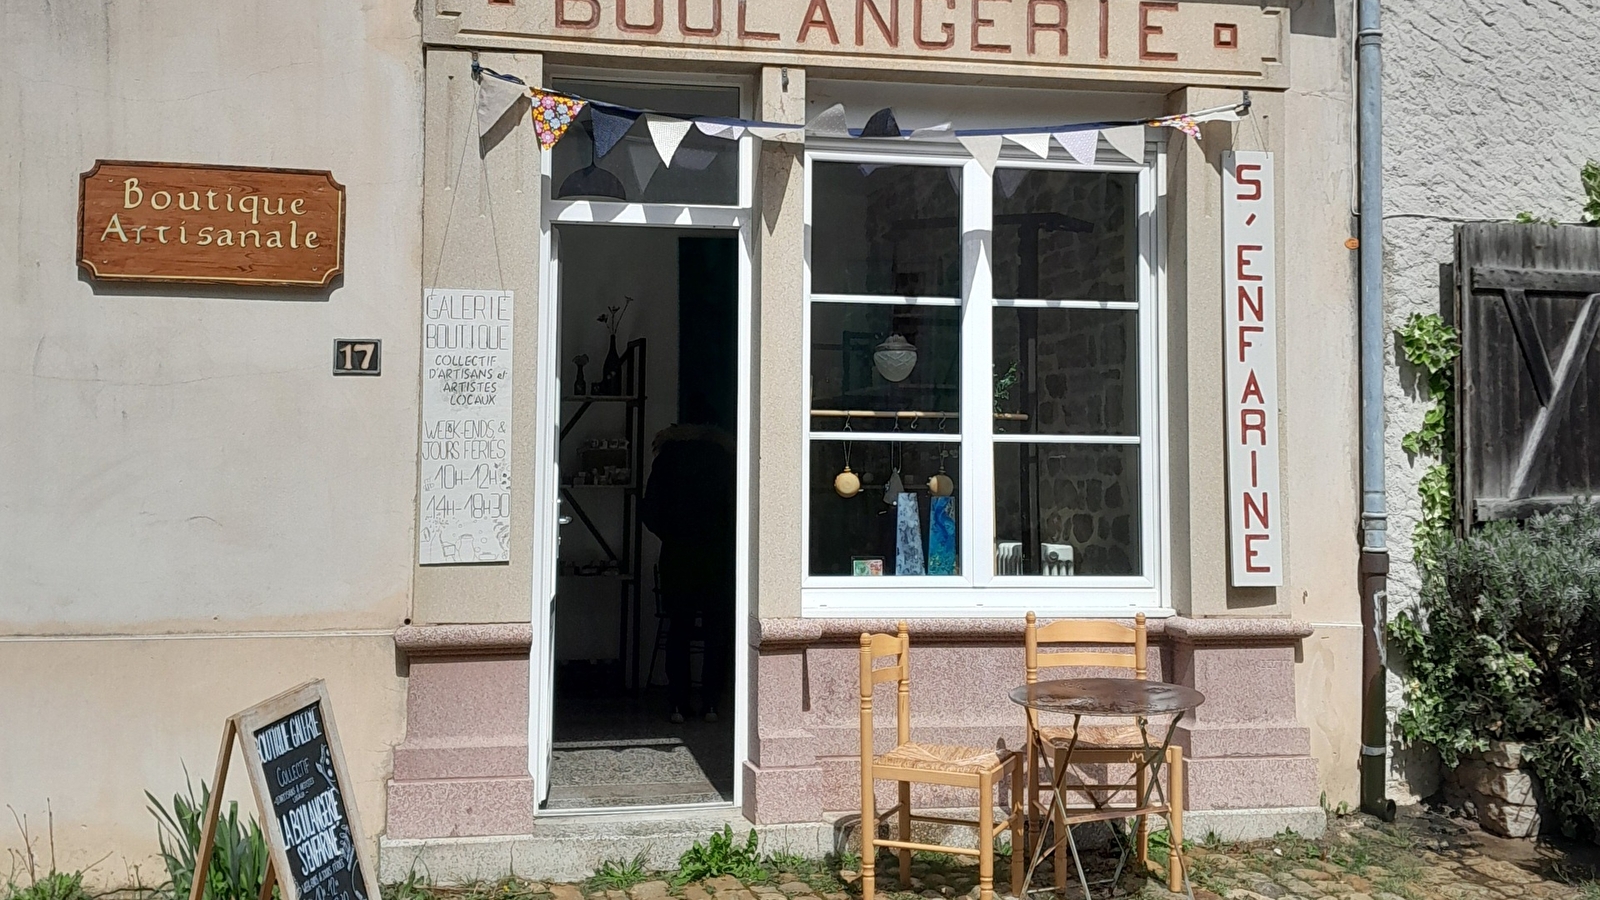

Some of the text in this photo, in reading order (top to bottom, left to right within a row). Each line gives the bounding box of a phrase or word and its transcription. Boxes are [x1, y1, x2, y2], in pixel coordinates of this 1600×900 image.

[555, 0, 1179, 61] BOULANGERIE
[123, 177, 308, 224] Boutique
[100, 213, 320, 249] Artisanale
[426, 295, 511, 321] GALERIE
[426, 324, 510, 350] BOUTIQUE
[339, 344, 375, 370] 17
[435, 355, 498, 366] COLLECTIF
[429, 368, 493, 379] D'ARTISANS
[443, 381, 497, 393] ARTISTES
[450, 394, 497, 406] LOCAUX
[497, 421, 506, 434] &
[421, 440, 460, 461] JOURS
